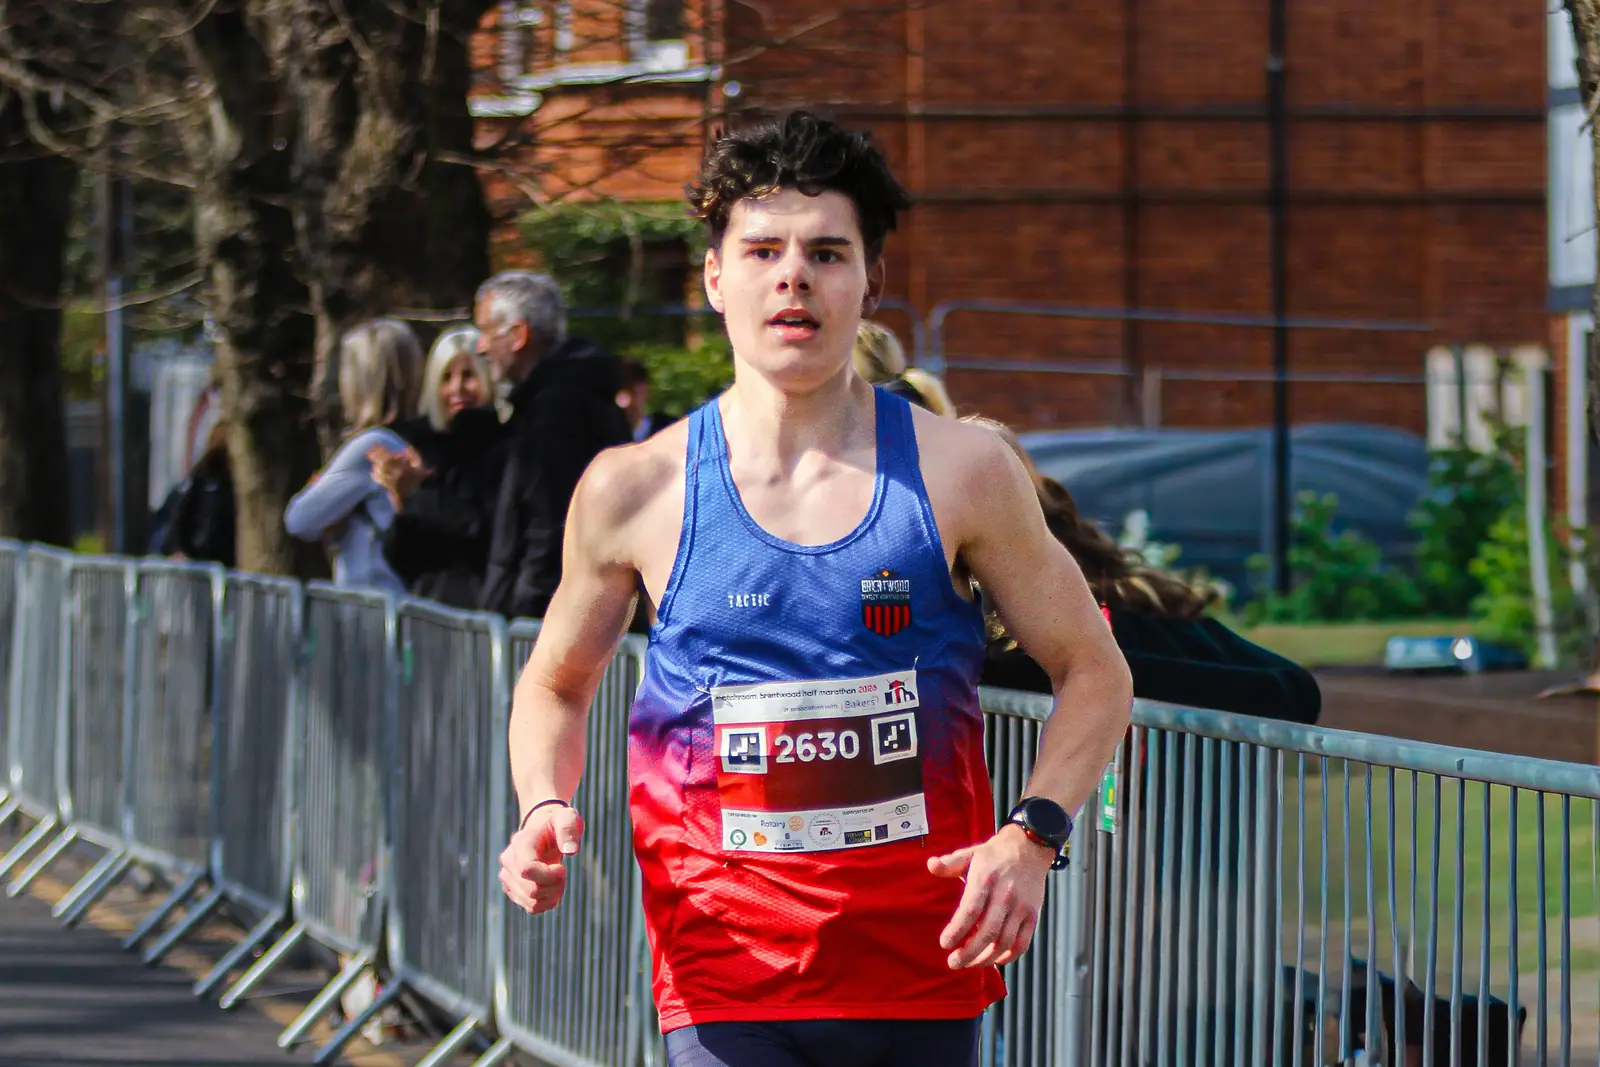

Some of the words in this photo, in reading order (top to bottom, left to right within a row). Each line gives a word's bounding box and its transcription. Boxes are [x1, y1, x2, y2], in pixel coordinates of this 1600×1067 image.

[727, 592, 771, 609] TACTIC
[760, 690, 801, 700] brentwood
[802, 689, 817, 697] half
[819, 687, 857, 696] marathon
[844, 699, 876, 709] Bakers
[774, 730, 860, 763] 2630
[760, 820, 786, 829] Rotary
